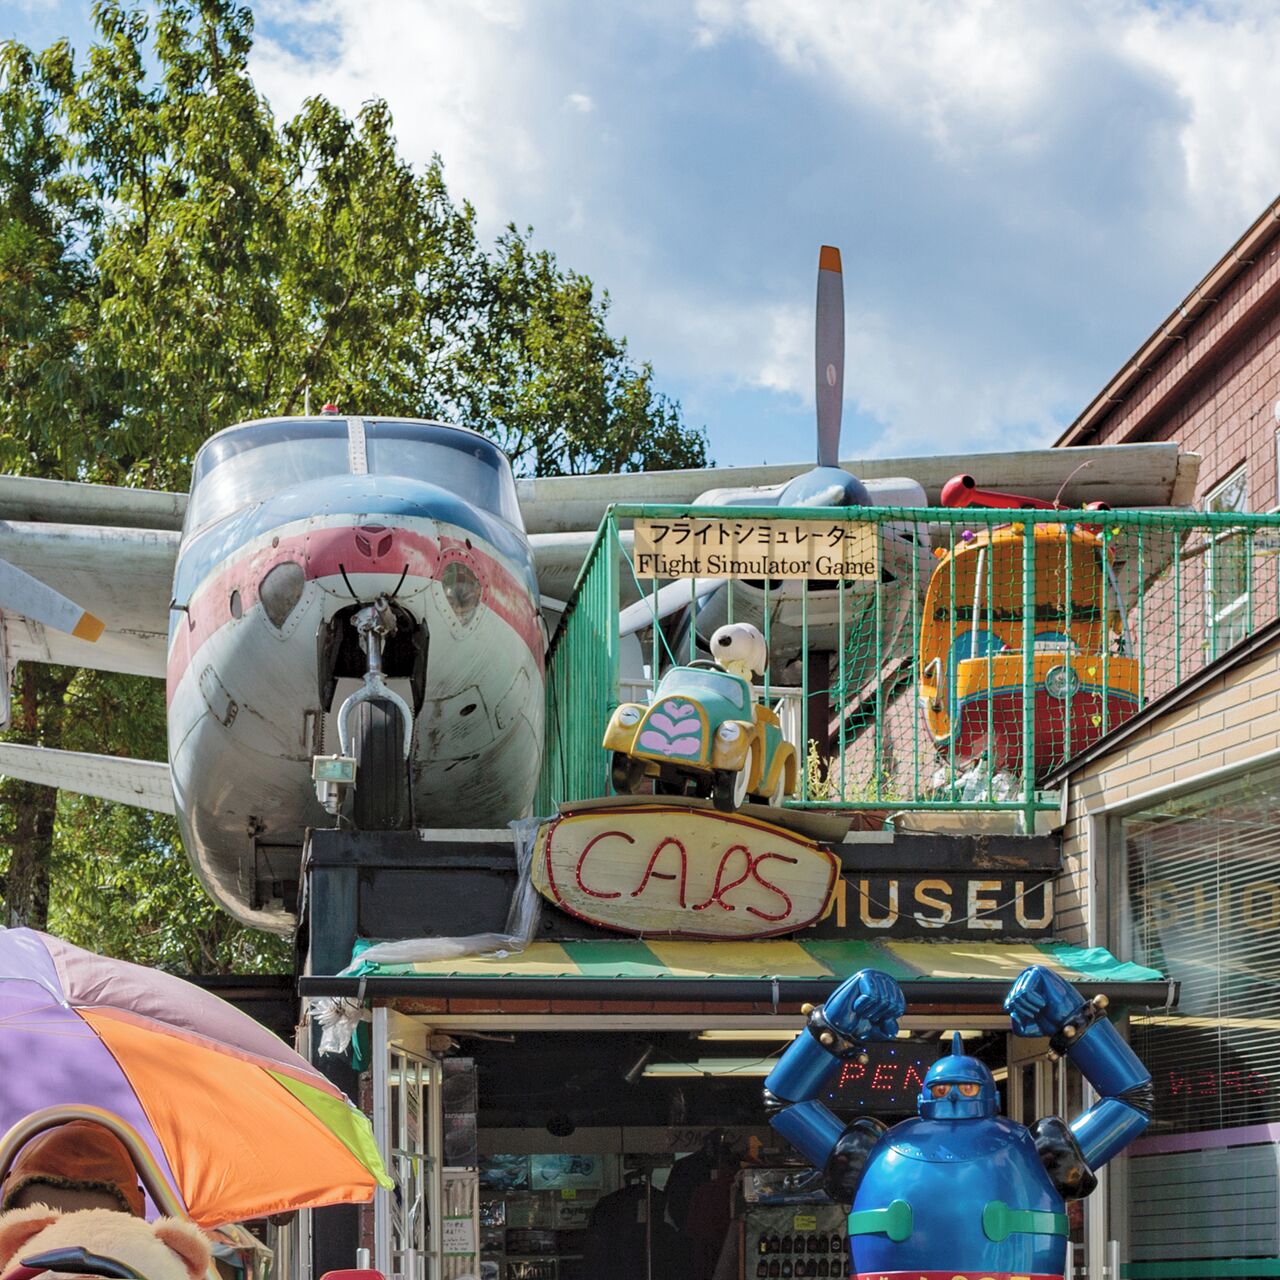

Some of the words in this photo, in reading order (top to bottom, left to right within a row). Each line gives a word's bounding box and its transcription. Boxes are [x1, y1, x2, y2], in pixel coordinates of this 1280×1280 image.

[650, 523, 857, 548] フライトシミュレーター
[637, 553, 701, 577] Flight
[707, 555, 810, 576] Simulator
[816, 556, 876, 577] Game
[575, 830, 798, 922] CARS
[838, 1062, 931, 1089] PEN
